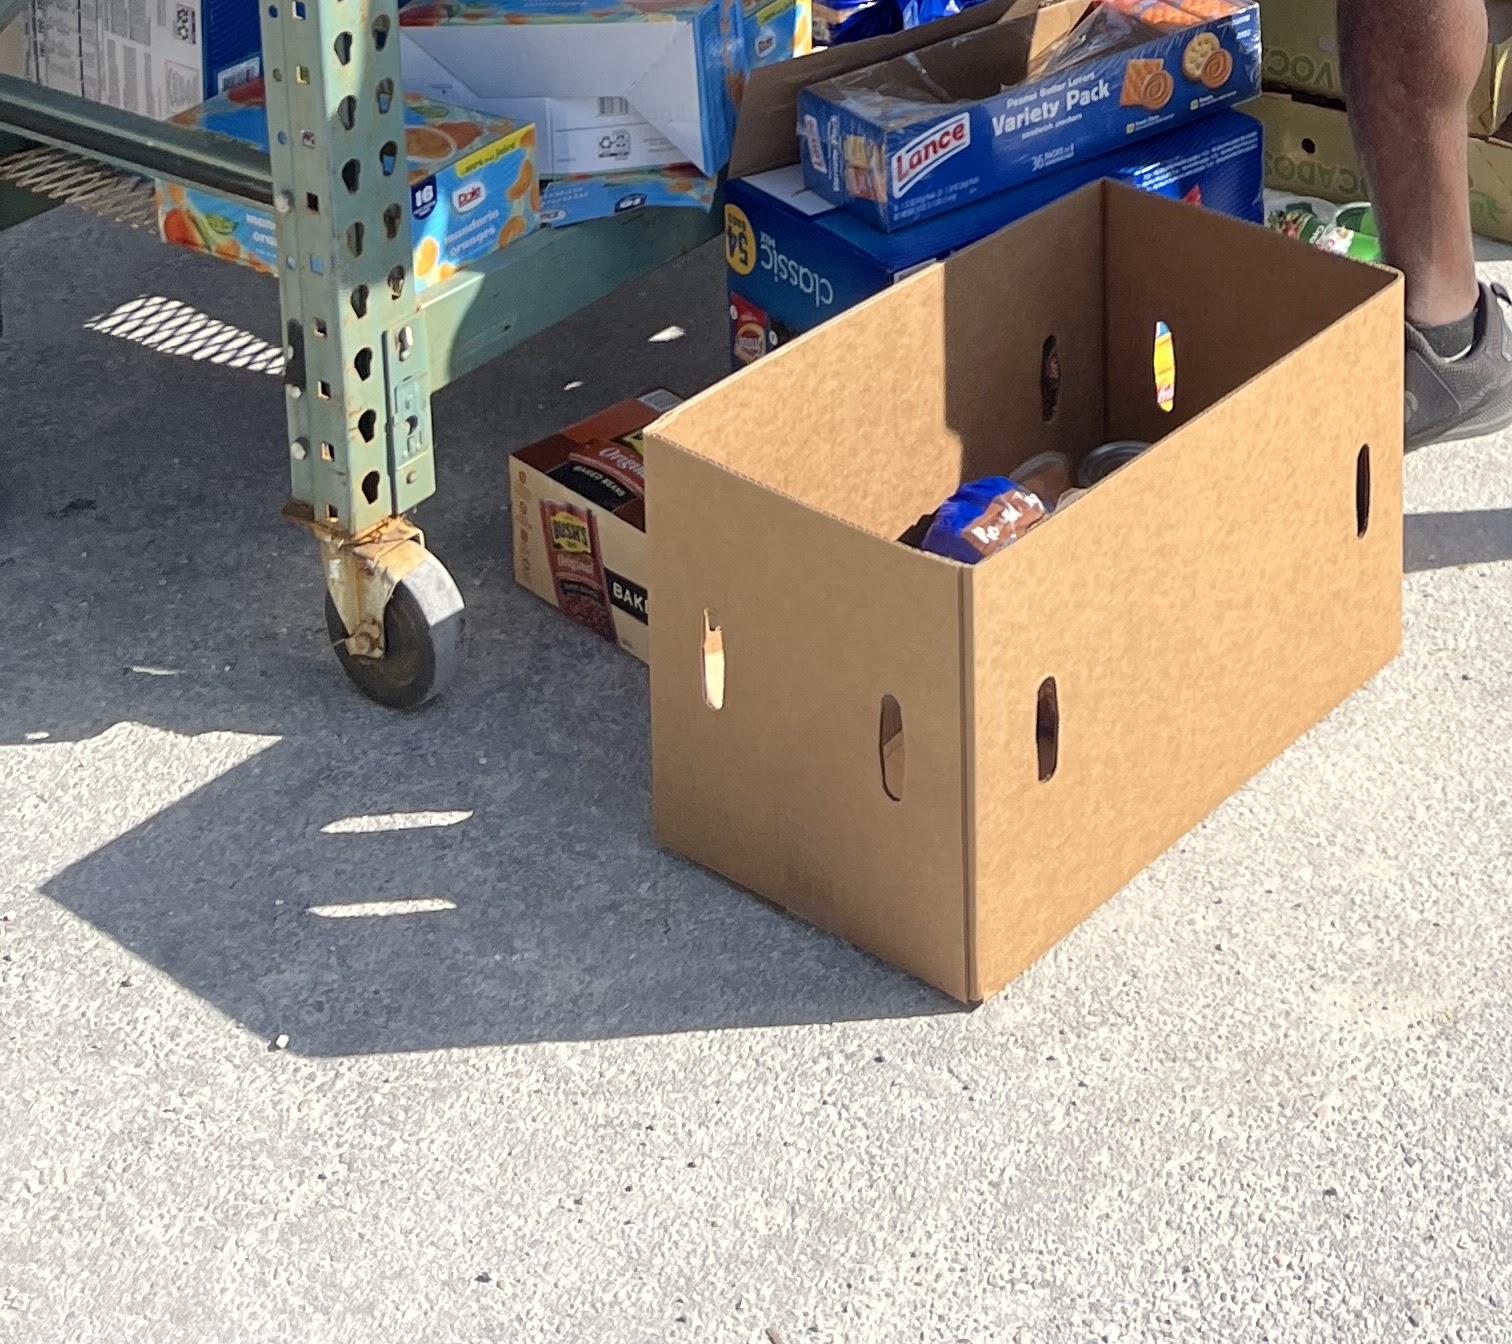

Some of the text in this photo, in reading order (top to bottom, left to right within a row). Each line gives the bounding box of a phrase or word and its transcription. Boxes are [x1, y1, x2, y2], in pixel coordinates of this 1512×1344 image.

[991, 78, 1111, 136] Variety Pack
[1006, 89, 1038, 109] Peanut
[1039, 82, 1066, 97] Butter
[896, 121, 967, 183] Lance
[458, 186, 481, 209] Dole
[449, 226, 497, 257] oranges
[726, 225, 749, 267] 54
[760, 243, 834, 308] classic
[553, 517, 588, 545] BUSH'S
[612, 580, 649, 614] BAK
